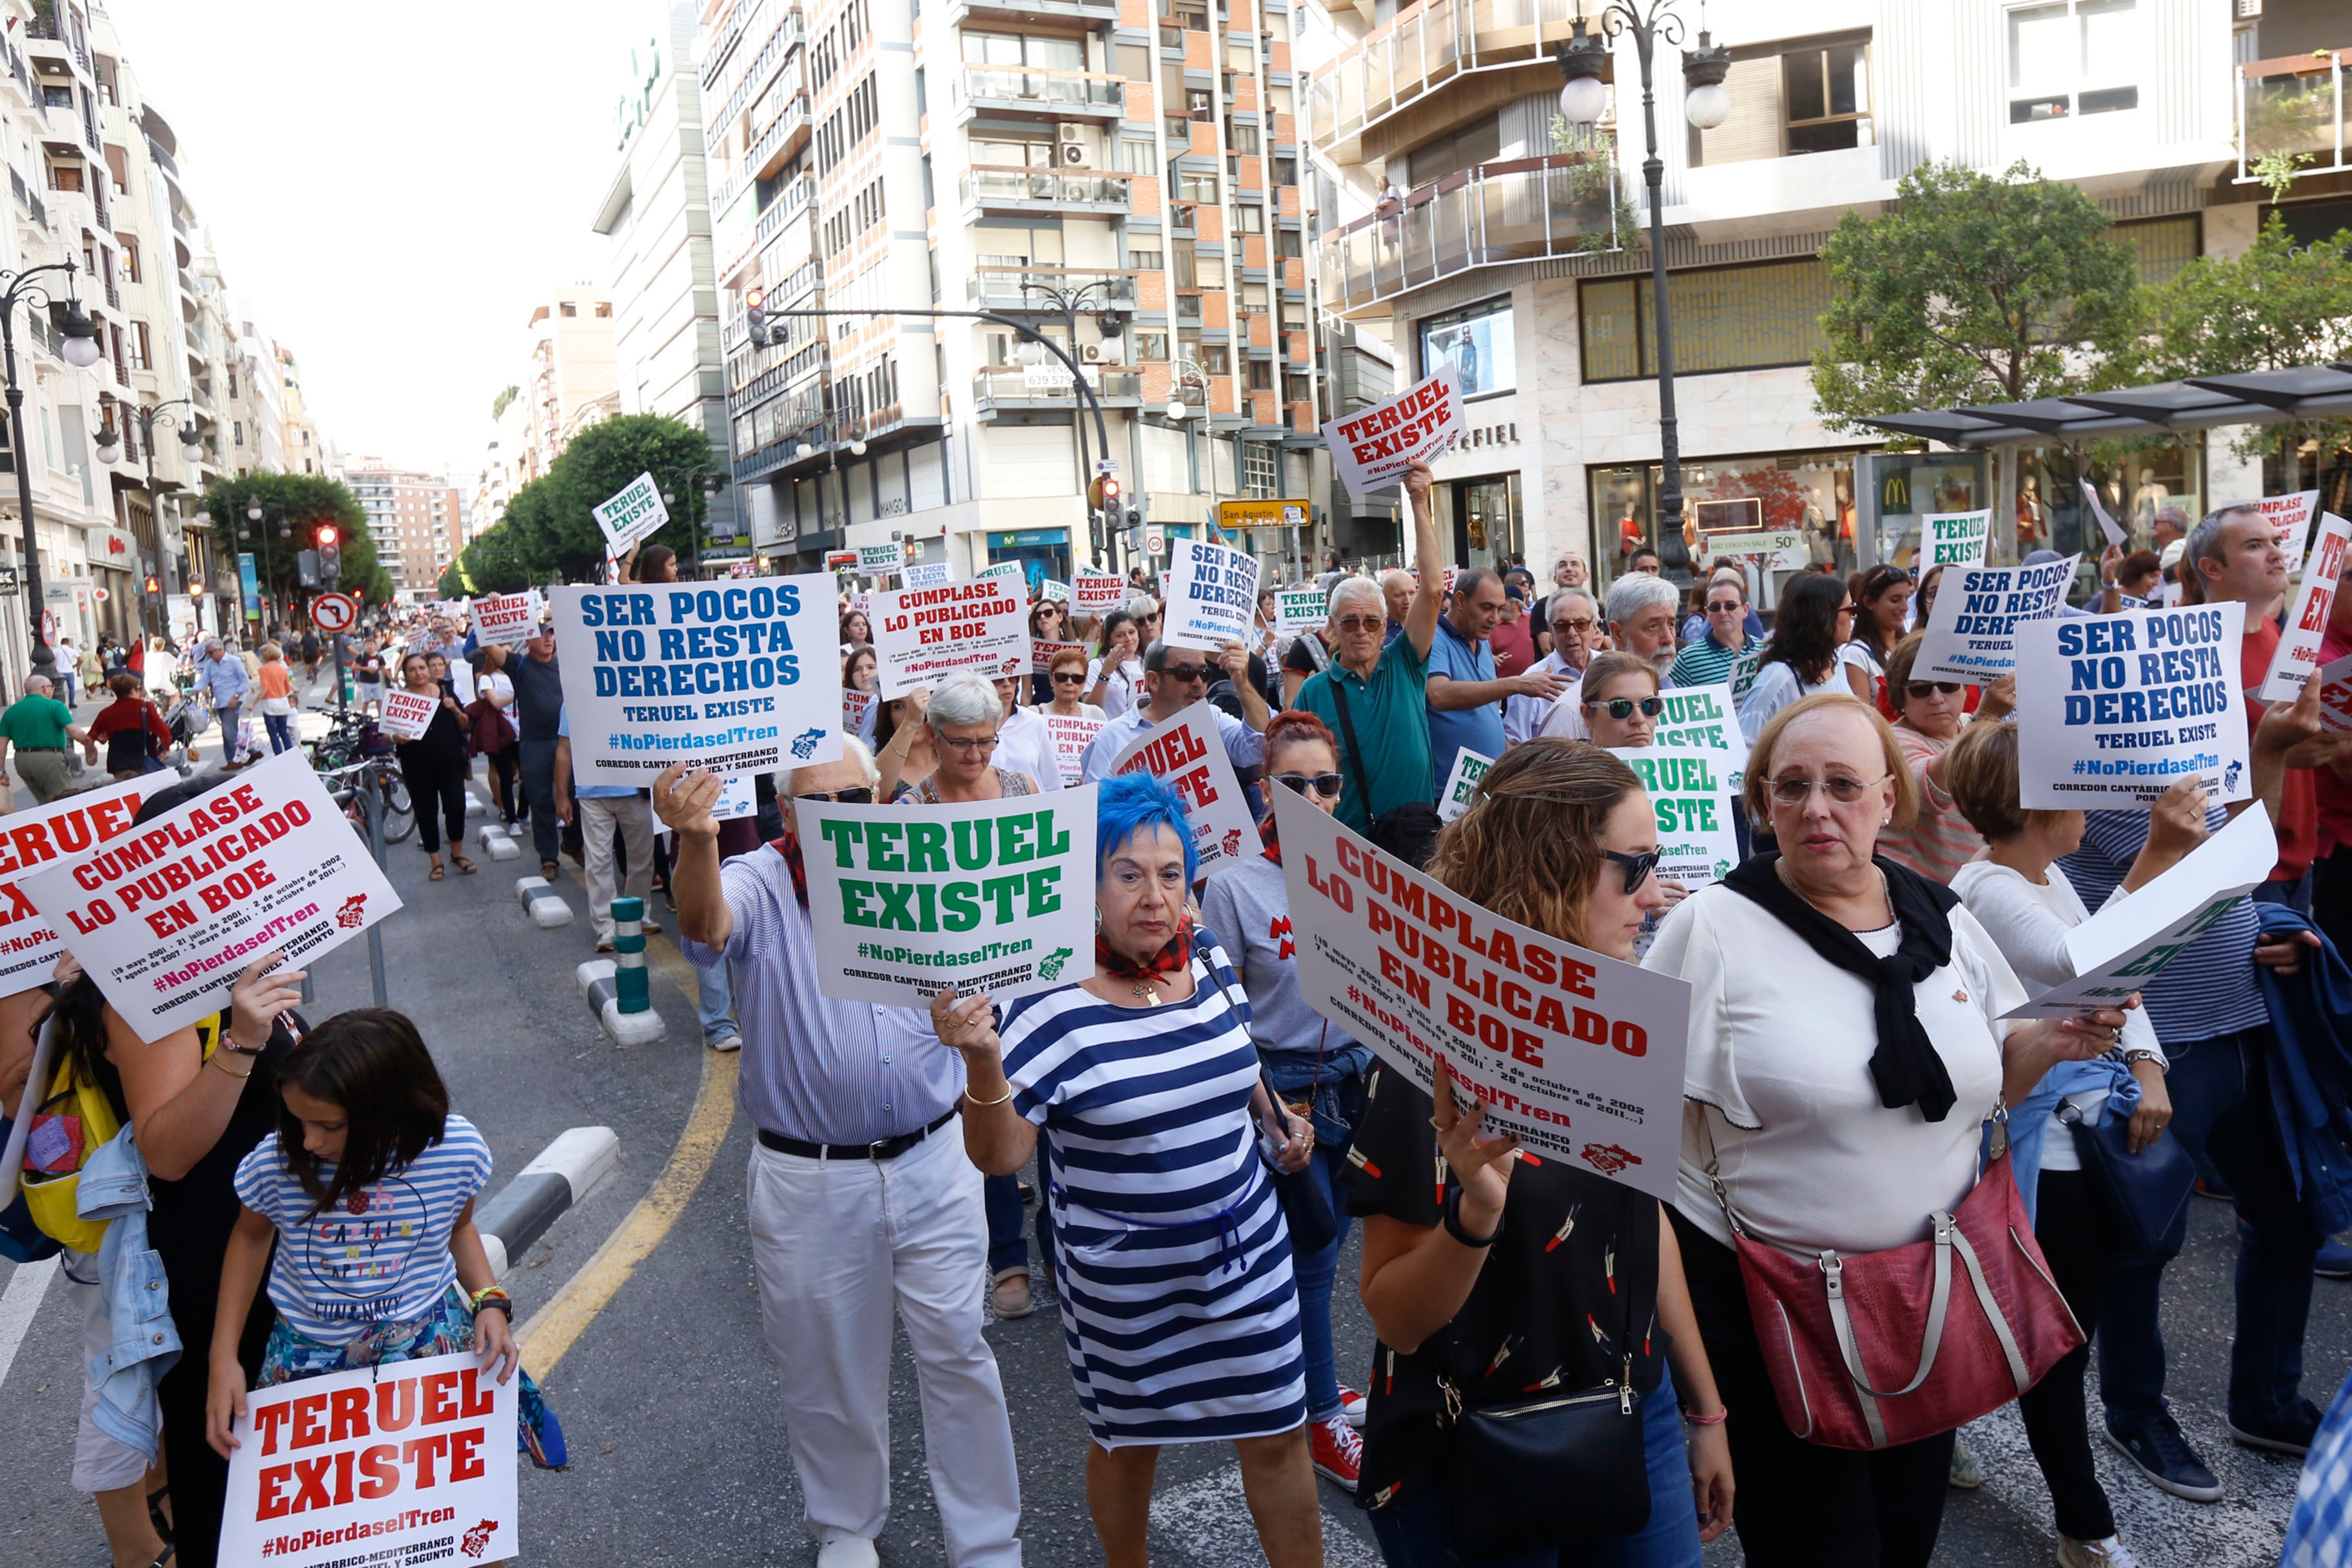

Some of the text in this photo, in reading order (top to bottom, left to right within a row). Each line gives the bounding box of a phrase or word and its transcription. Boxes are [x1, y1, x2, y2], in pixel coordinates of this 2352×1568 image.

[1028, 375, 1048, 384] 639
[1052, 375, 1072, 384] 579
[1337, 378, 1449, 444] TERUEL
[1351, 400, 1452, 465] EXISTE
[602, 482, 651, 518] TERUEL
[611, 495, 655, 532] EXISTE
[880, 498, 903, 515] MANGO
[1223, 511, 1239, 519] San
[1933, 516, 1985, 539] TERUEL
[860, 546, 897, 556] TERUEL
[863, 555, 897, 564] EXISTE
[1191, 544, 1257, 580] SER POCOS
[1934, 540, 1983, 564] EXISTE
[1076, 578, 1123, 588] TERUEL
[1195, 564, 1253, 596] NO RESTA
[1963, 561, 2071, 592] SER POCOS
[474, 596, 529, 615] TERUEL
[581, 584, 801, 627] SER POCOS
[899, 582, 999, 610] CÚMPLASE
[1078, 589, 1121, 600] EXISTE
[1189, 582, 1252, 614] DERECHOS
[1281, 593, 1324, 605] TERUE
[1965, 585, 2061, 613] NO RESTA
[480, 609, 529, 627] EXISTE
[885, 599, 1016, 632] LO PUBLICADO
[1201, 605, 1234, 618] TERUEL
[594, 621, 793, 662] NO RESTA
[919, 622, 986, 644] EN BOE
[1968, 640, 2014, 650] TERUEL
[2057, 610, 2222, 656] SER POCOS
[593, 654, 800, 697] DERECHOS
[905, 653, 997, 673] #NoPierdaselTren
[2071, 645, 2223, 691] NO RESTA
[386, 706, 427, 723] EXISTE
[389, 692, 432, 711] TERUEL
[623, 697, 775, 723] TERUEL EXISTE
[2064, 681, 2228, 726] DERECHOS
[609, 725, 778, 750] #NoPierdaselTren
[1059, 744, 1073, 753] EN
[2095, 723, 2217, 750] TERUEL EXISTE
[596, 760, 640, 769] CORREDOR
[735, 756, 778, 769] SAGUNTO
[2073, 753, 2219, 776] #NoPierdaselTren
[2053, 783, 2107, 792] CORREDOR
[72, 783, 263, 891] CÚMPLASE
[820, 809, 1070, 872] TERUEL
[66, 899, 116, 935] LO
[115, 799, 311, 911] PUBLICADO
[144, 859, 277, 939] EN BOE
[838, 865, 1061, 932] EXISTE
[126, 957, 146, 973] mayo
[148, 948, 166, 960] 2001
[177, 938, 186, 946] 21
[190, 930, 206, 943] julio
[222, 911, 242, 923] 2001
[263, 894, 274, 903] de
[277, 876, 306, 895] octubre
[308, 868, 318, 876] de
[320, 854, 342, 870] 2002
[1335, 836, 1596, 1001] CÚMPLASE
[124, 965, 149, 981] agosto
[150, 961, 161, 969] de
[162, 950, 181, 963] 2007
[198, 932, 219, 948] mayo
[221, 925, 231, 933] de
[233, 916, 251, 928] 2011
[262, 903, 273, 913] 28
[275, 886, 306, 904] octubre
[306, 878, 317, 887] de
[153, 902, 320, 993] #NoPierdaselTren
[283, 928, 335, 963] Y SAGUNTO
[858, 938, 1032, 966] #NoPierdaselTren
[1305, 854, 1355, 914] LO
[1368, 897, 1648, 1059] PUBLICADO
[843, 968, 892, 982] CORREDOR
[917, 973, 1032, 998] POR Y SAGUNTO
[152, 990, 199, 1015] CORREDOR
[1378, 945, 1544, 1069] EN BOE
[1324, 950, 1353, 976] agosto
[1357, 973, 1367, 985] de
[1371, 985, 1394, 1004] 2007
[1417, 1019, 1442, 1042] mayo
[1445, 1041, 1456, 1053] de
[1460, 1052, 1484, 1069] 2011
[1500, 1072, 1516, 1084] 28
[1522, 1081, 1569, 1102] octubre
[1575, 1097, 1591, 1108] de
[1329, 995, 1387, 1042] CORREDOR
[1332, 947, 1645, 1115] mayo 2001 21 julio de 2001 2 de octubre de 2002
[1486, 1124, 1494, 1134] Y
[320, 1220, 413, 1243] CAPTAIN
[346, 1242, 378, 1260] MY
[320, 1256, 401, 1279] CAPTAIN
[254, 1367, 494, 1457] TERUEL
[256, 1427, 485, 1522] EXISTE
[262, 1506, 455, 1558] #NoPierdaselTren
[405, 1547, 454, 1567] SAGUNTO
